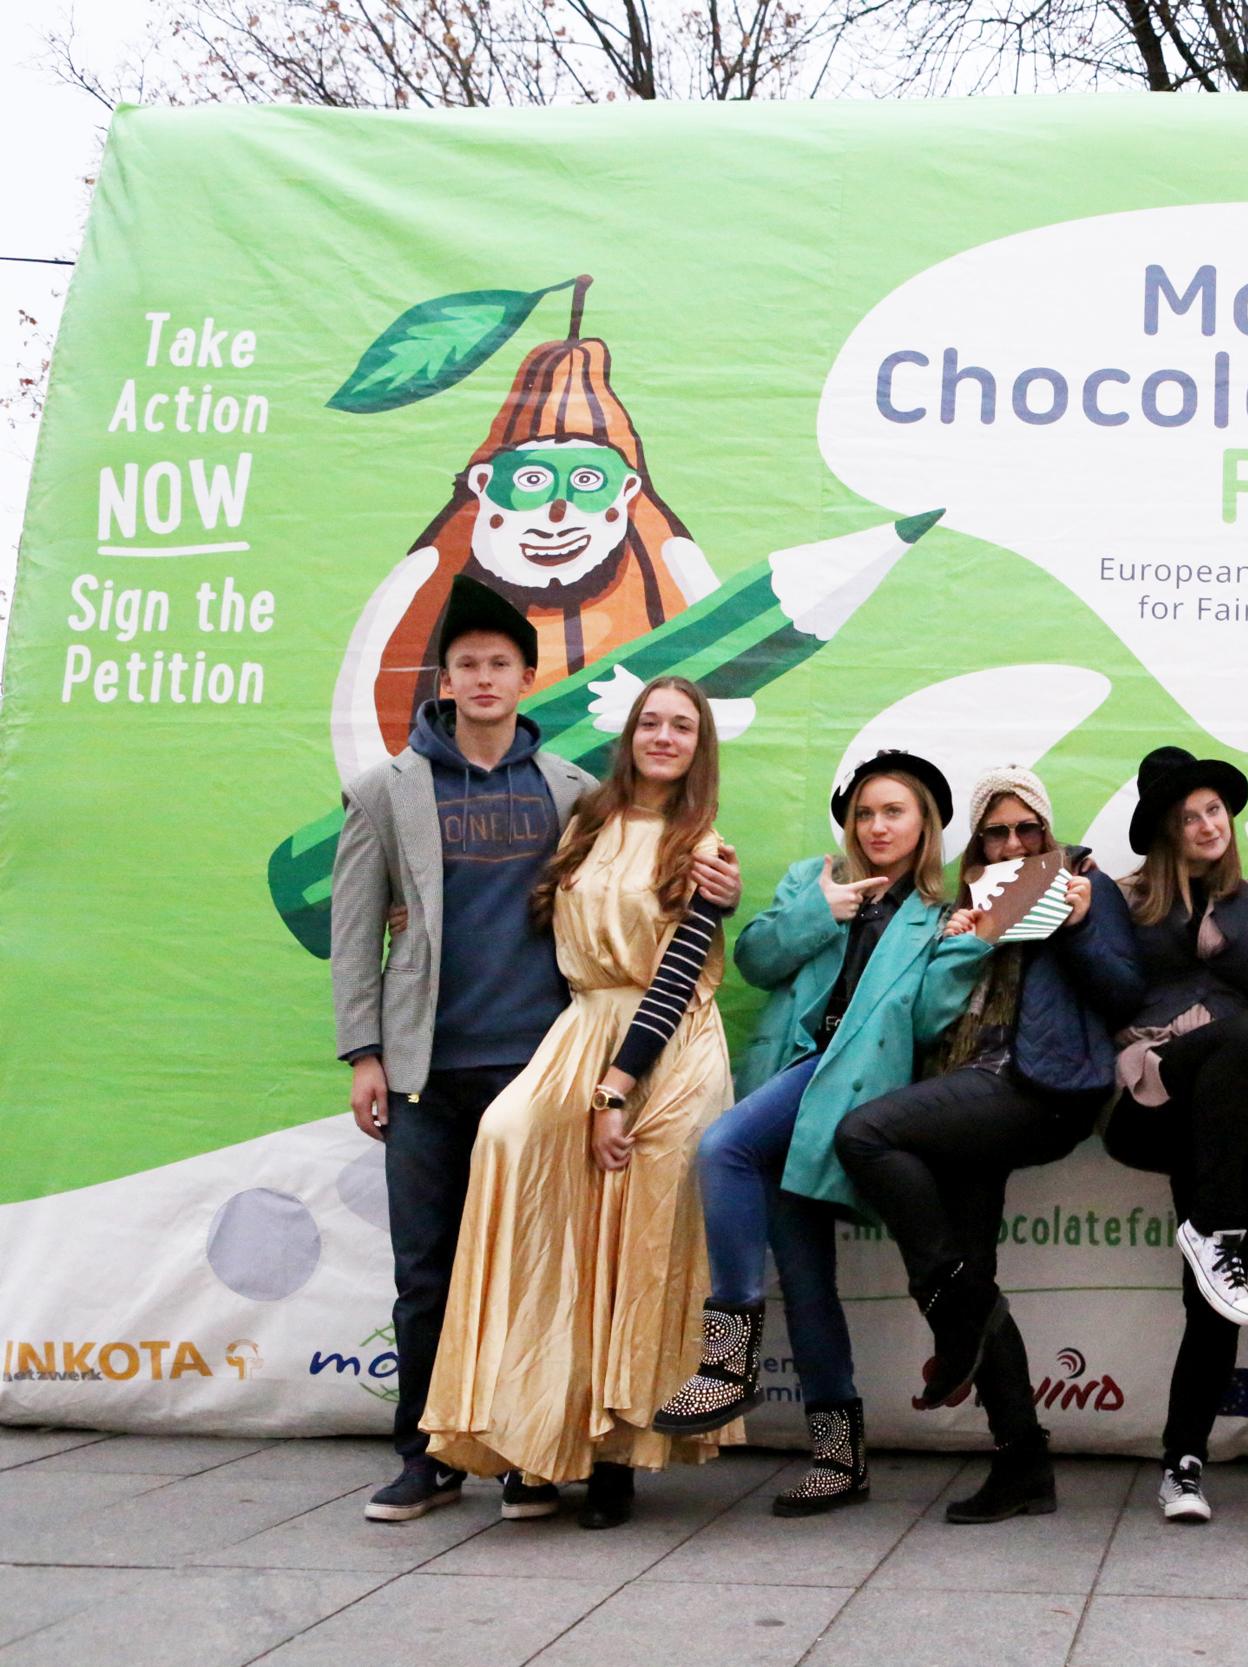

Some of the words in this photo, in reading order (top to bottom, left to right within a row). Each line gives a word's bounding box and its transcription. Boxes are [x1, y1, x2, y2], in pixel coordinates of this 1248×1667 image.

[145, 312, 256, 368] Take
[108, 378, 269, 433] Action
[97, 452, 253, 541] NOW
[68, 574, 169, 642] Sign
[196, 576, 275, 633] the
[1138, 595, 1184, 620] for
[62, 645, 265, 704] Petition
[2, 1340, 214, 1381] INKOTA
[309, 1351, 400, 1378] mo
